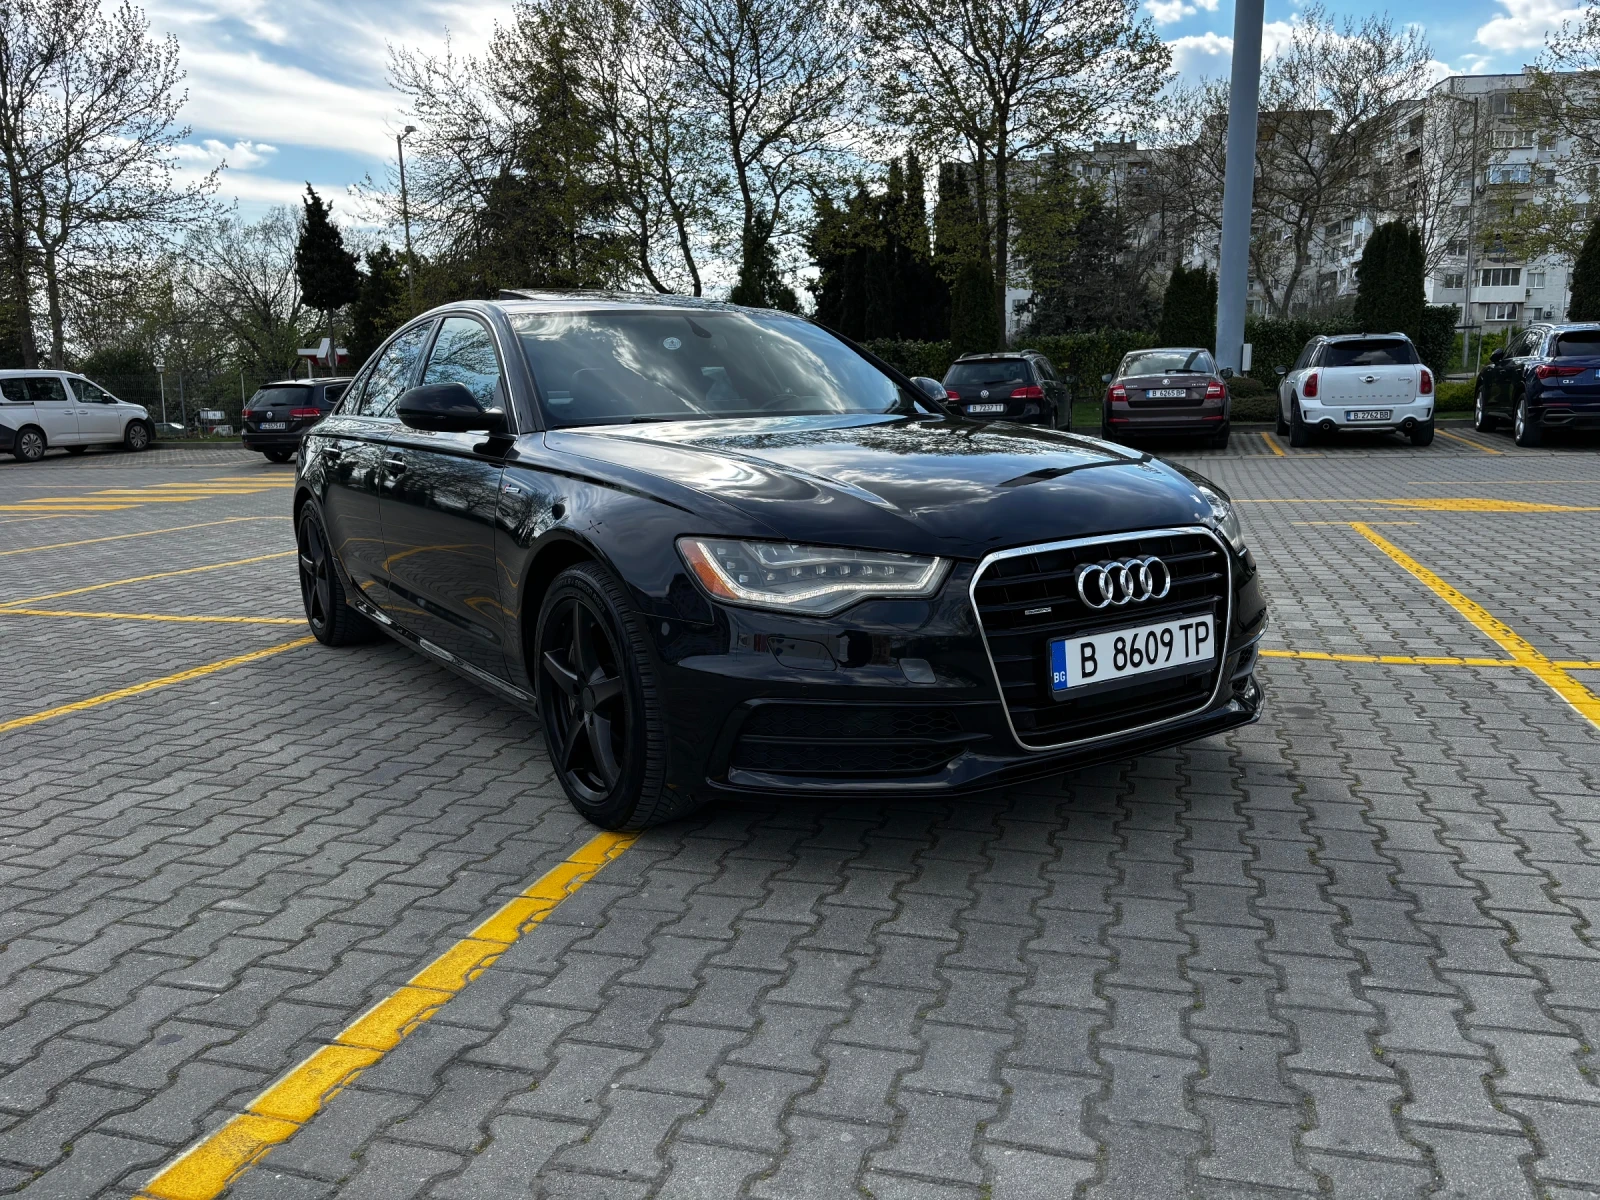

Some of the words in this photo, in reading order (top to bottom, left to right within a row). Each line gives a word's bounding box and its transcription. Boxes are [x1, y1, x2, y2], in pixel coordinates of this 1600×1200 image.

[1080, 641, 1098, 679] B
[1113, 628, 1174, 671] 8609
[1178, 621, 1210, 658] TP
[1053, 671, 1066, 683] BG
